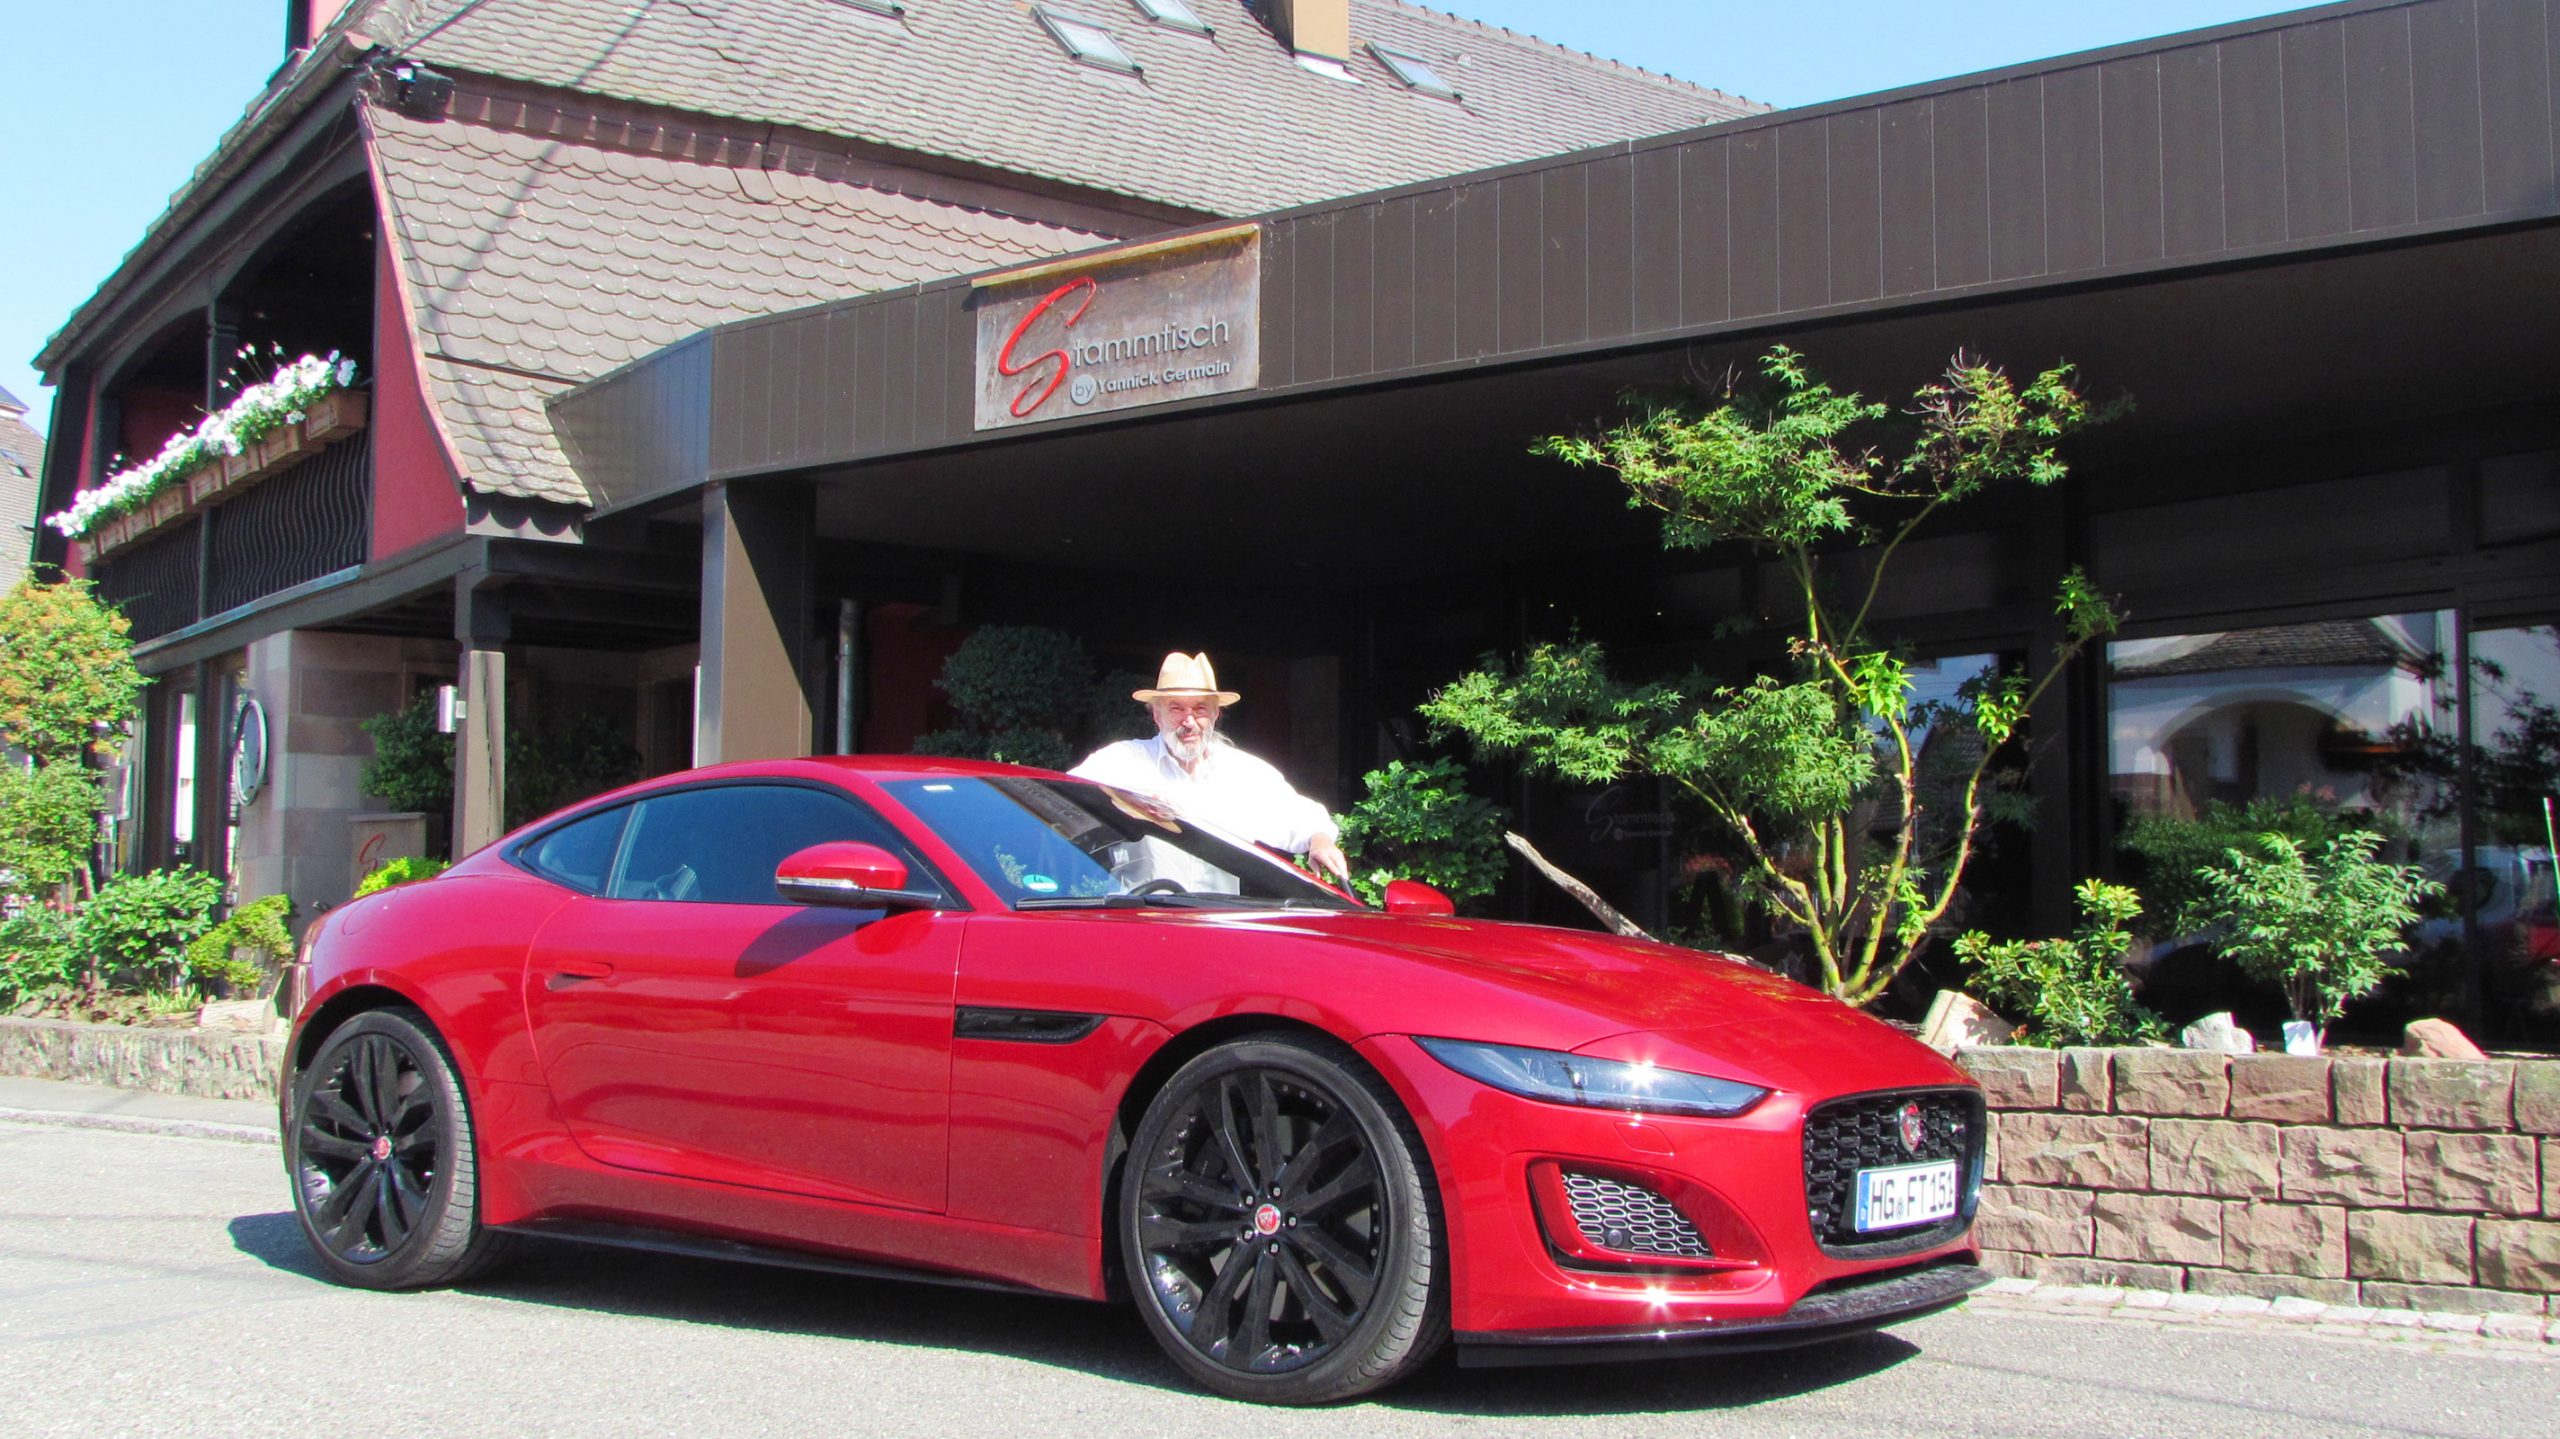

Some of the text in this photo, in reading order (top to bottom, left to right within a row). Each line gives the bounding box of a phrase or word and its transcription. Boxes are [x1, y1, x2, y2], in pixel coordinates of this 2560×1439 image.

[998, 276, 1229, 417] Stammtisch
[1098, 372, 1159, 394] Yannick
[1162, 359, 1231, 383] Germain
[1871, 1179, 1895, 1222] HG
